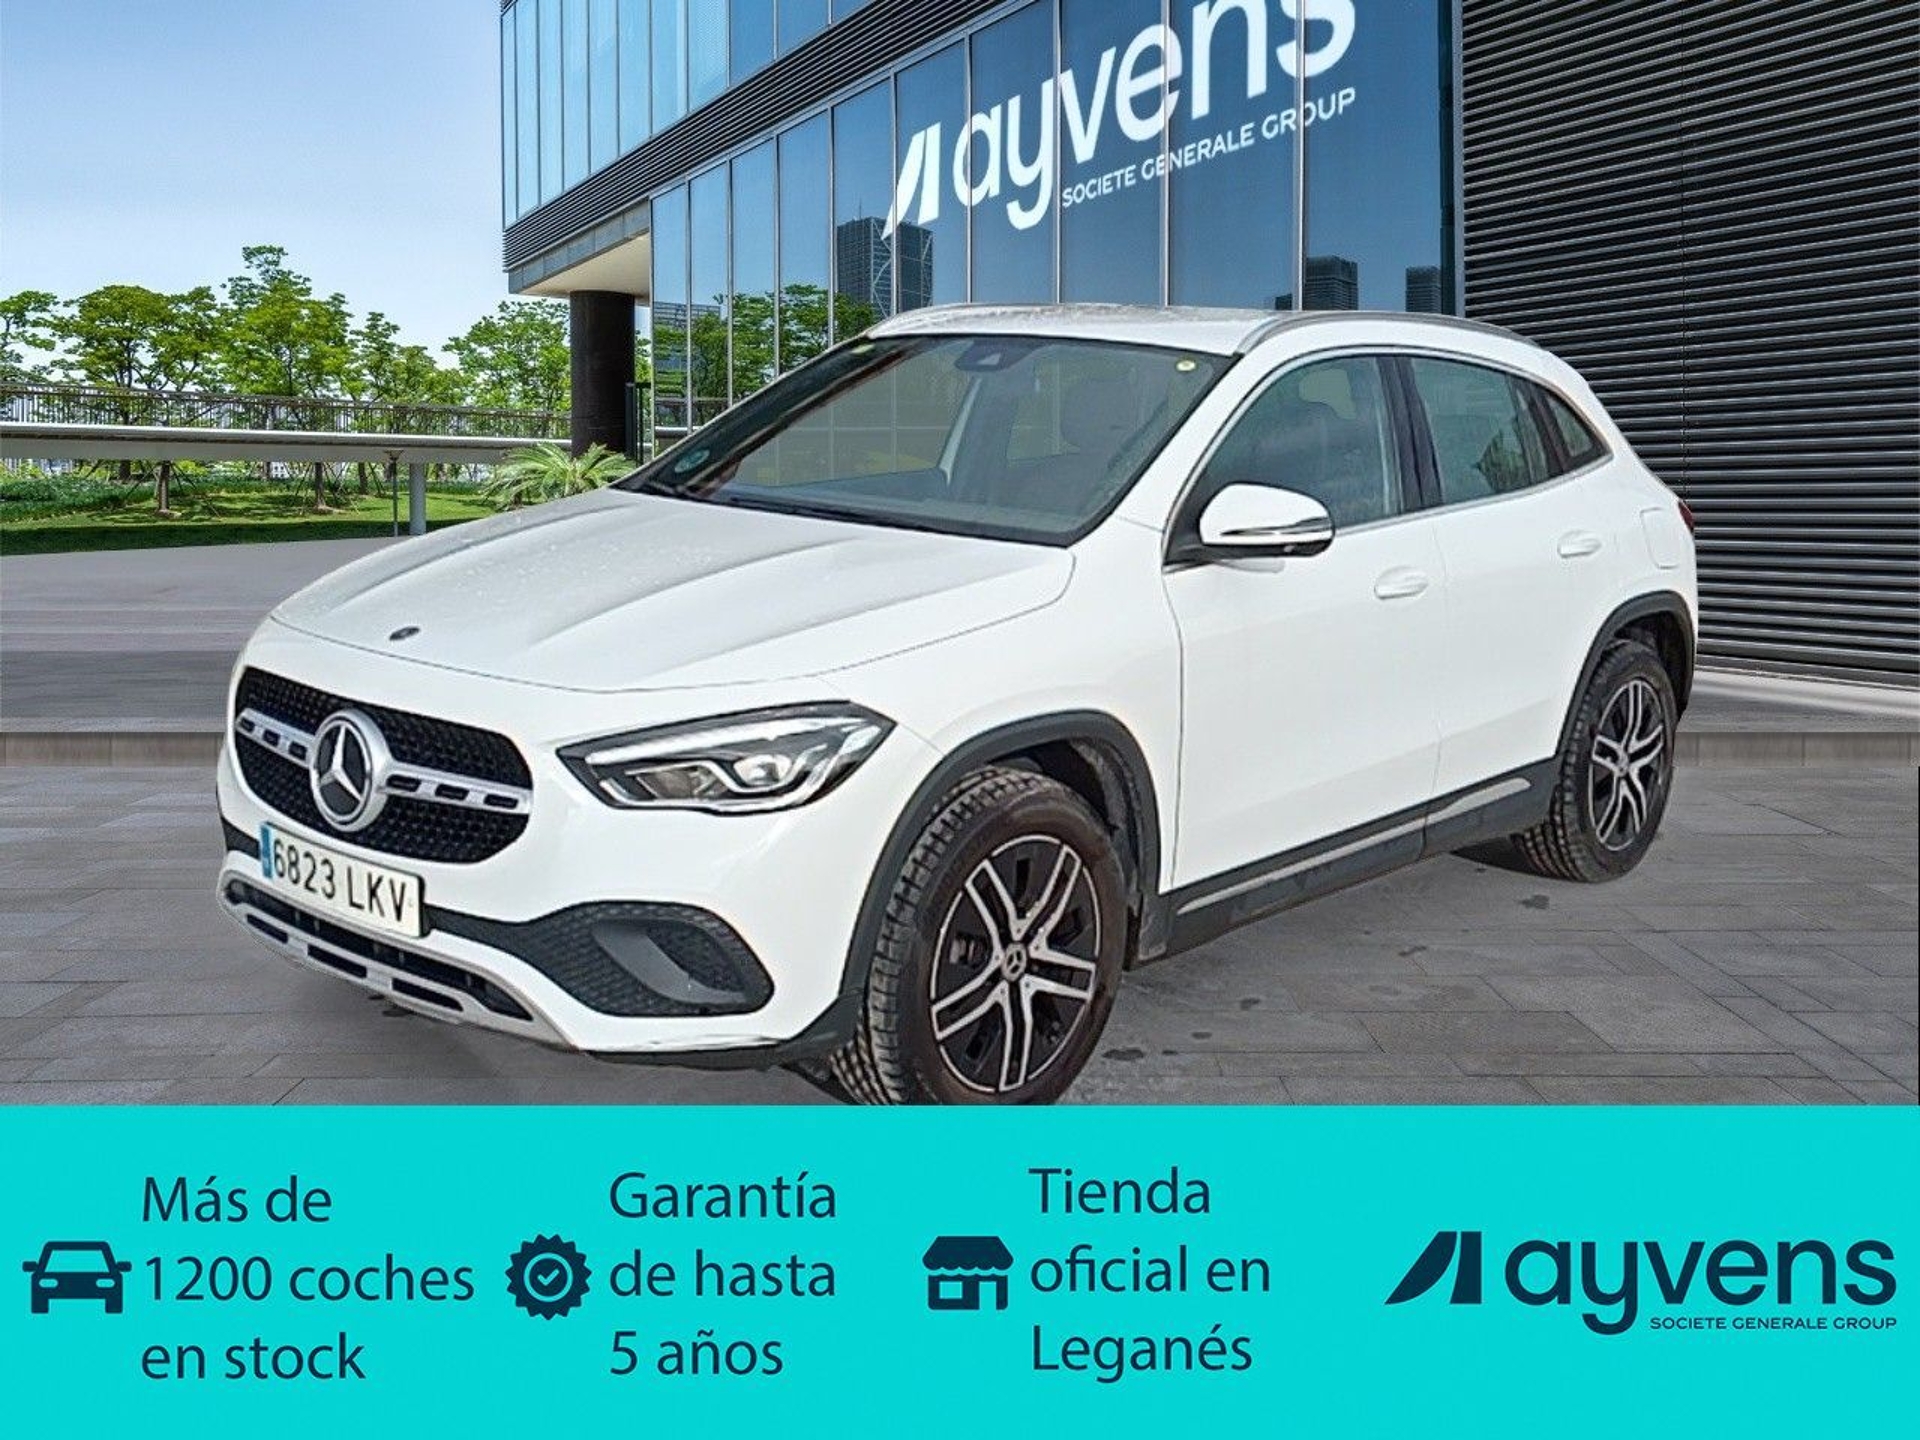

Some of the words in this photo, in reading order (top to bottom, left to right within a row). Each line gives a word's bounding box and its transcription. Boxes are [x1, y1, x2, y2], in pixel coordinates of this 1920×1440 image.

[952, 0, 1356, 230] ayvens
[1062, 166, 1138, 208] SOCIETE
[1142, 121, 1255, 181] GENERALE
[1261, 86, 1357, 140] GROUP
[273, 838, 336, 900] 6823
[347, 865, 406, 922] LKV
